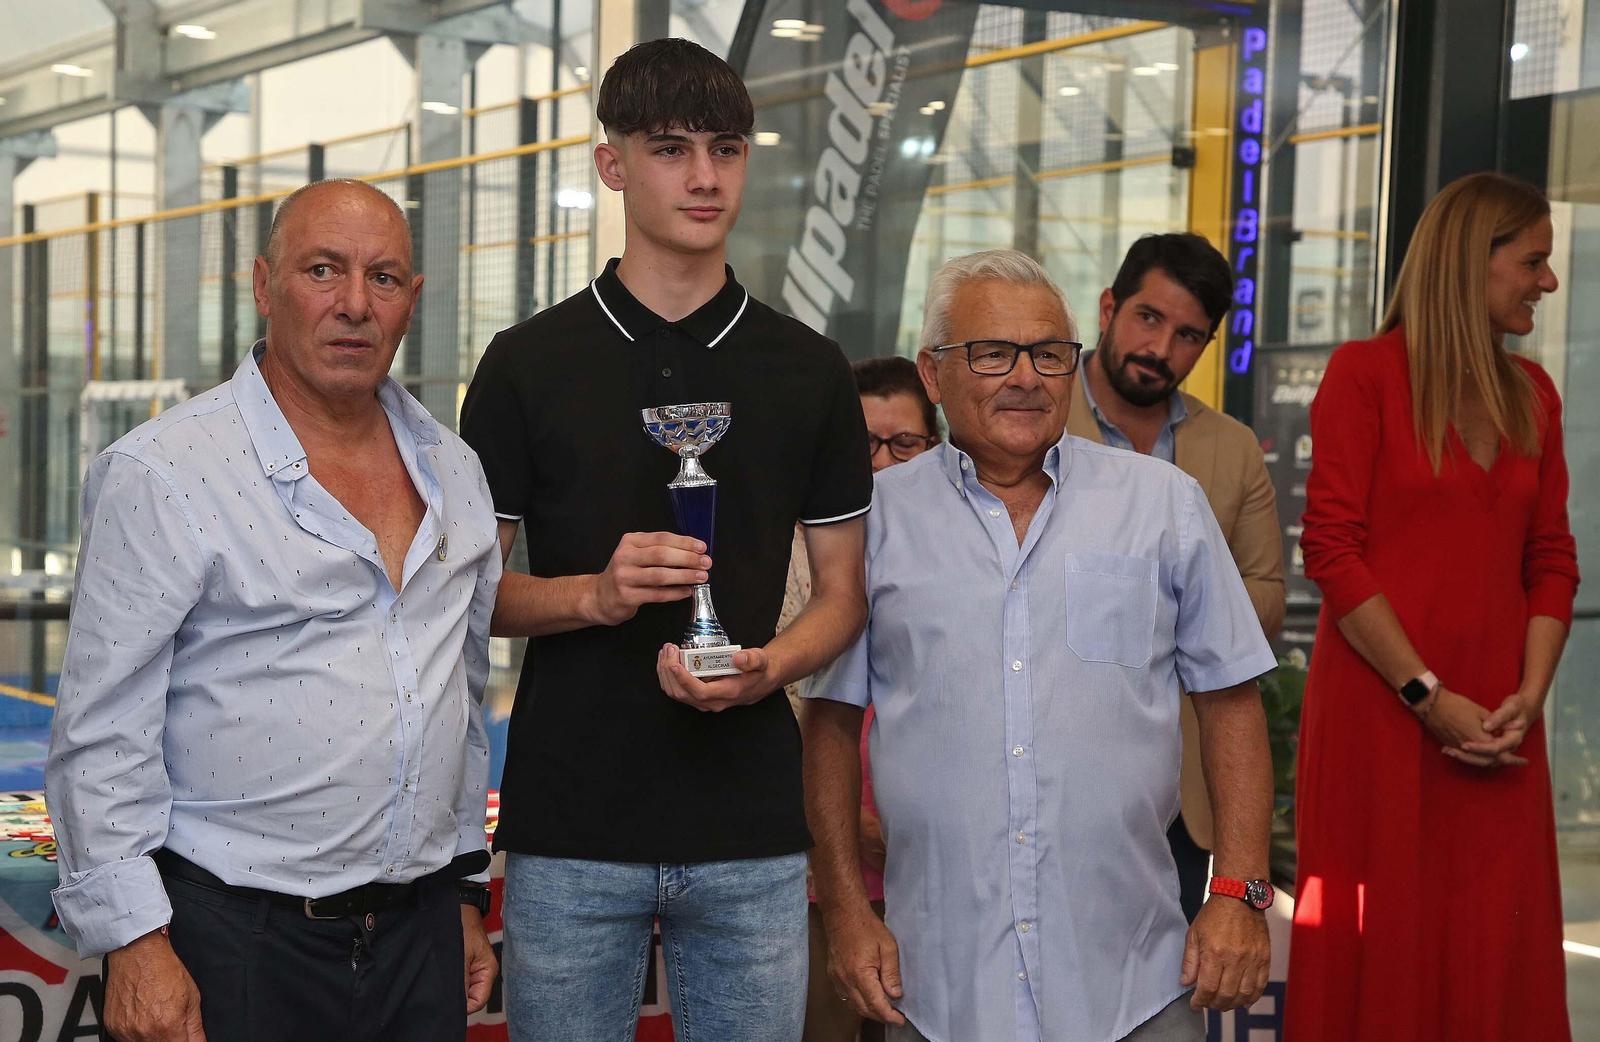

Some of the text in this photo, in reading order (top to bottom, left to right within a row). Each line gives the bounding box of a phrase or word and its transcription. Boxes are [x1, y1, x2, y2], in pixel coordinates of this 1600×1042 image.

[779, 0, 895, 335] llpadel
[865, 147, 888, 197] PADEL
[1229, 27, 1267, 374] PadelBrand
